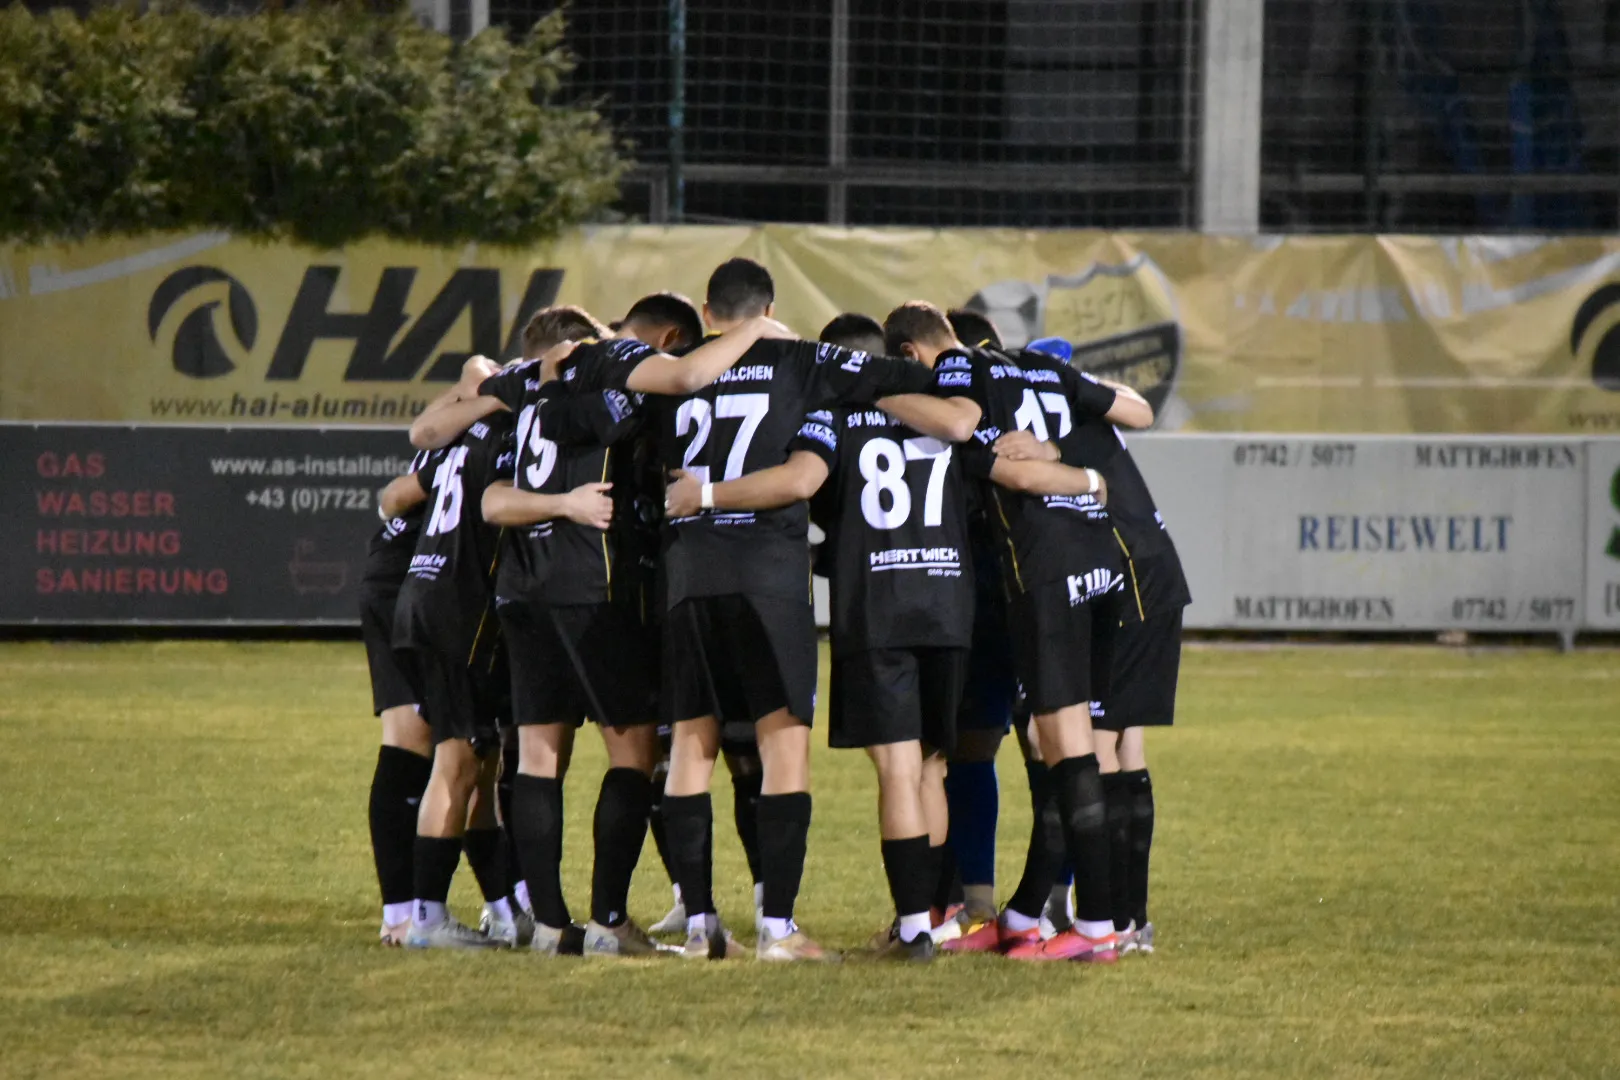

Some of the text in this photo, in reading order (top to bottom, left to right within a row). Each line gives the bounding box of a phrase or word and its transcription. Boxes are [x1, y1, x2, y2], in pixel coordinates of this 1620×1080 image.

[265, 265, 566, 382] HAI
[150, 393, 426, 419] www.hai-aluminiu
[676, 388, 770, 486] 27
[37, 452, 105, 478] GAS
[211, 456, 411, 477] www.as-installatio
[1234, 444, 1289, 468] 07742
[1311, 444, 1358, 468] 5077
[1416, 445, 1578, 468] MATTIGHOFEN
[858, 437, 953, 530] 87
[38, 492, 175, 517] WASSER
[246, 489, 285, 510] +43
[292, 488, 371, 513] (0)7722
[38, 530, 181, 556] HEIZUNG
[1298, 515, 1514, 553] REISEWELT
[870, 548, 960, 565] HERTWICH
[38, 569, 229, 595] SANIERUNG
[1235, 597, 1396, 621] MATTIGHOFEN
[1452, 599, 1507, 622] 07742
[1529, 599, 1577, 622] 5077
